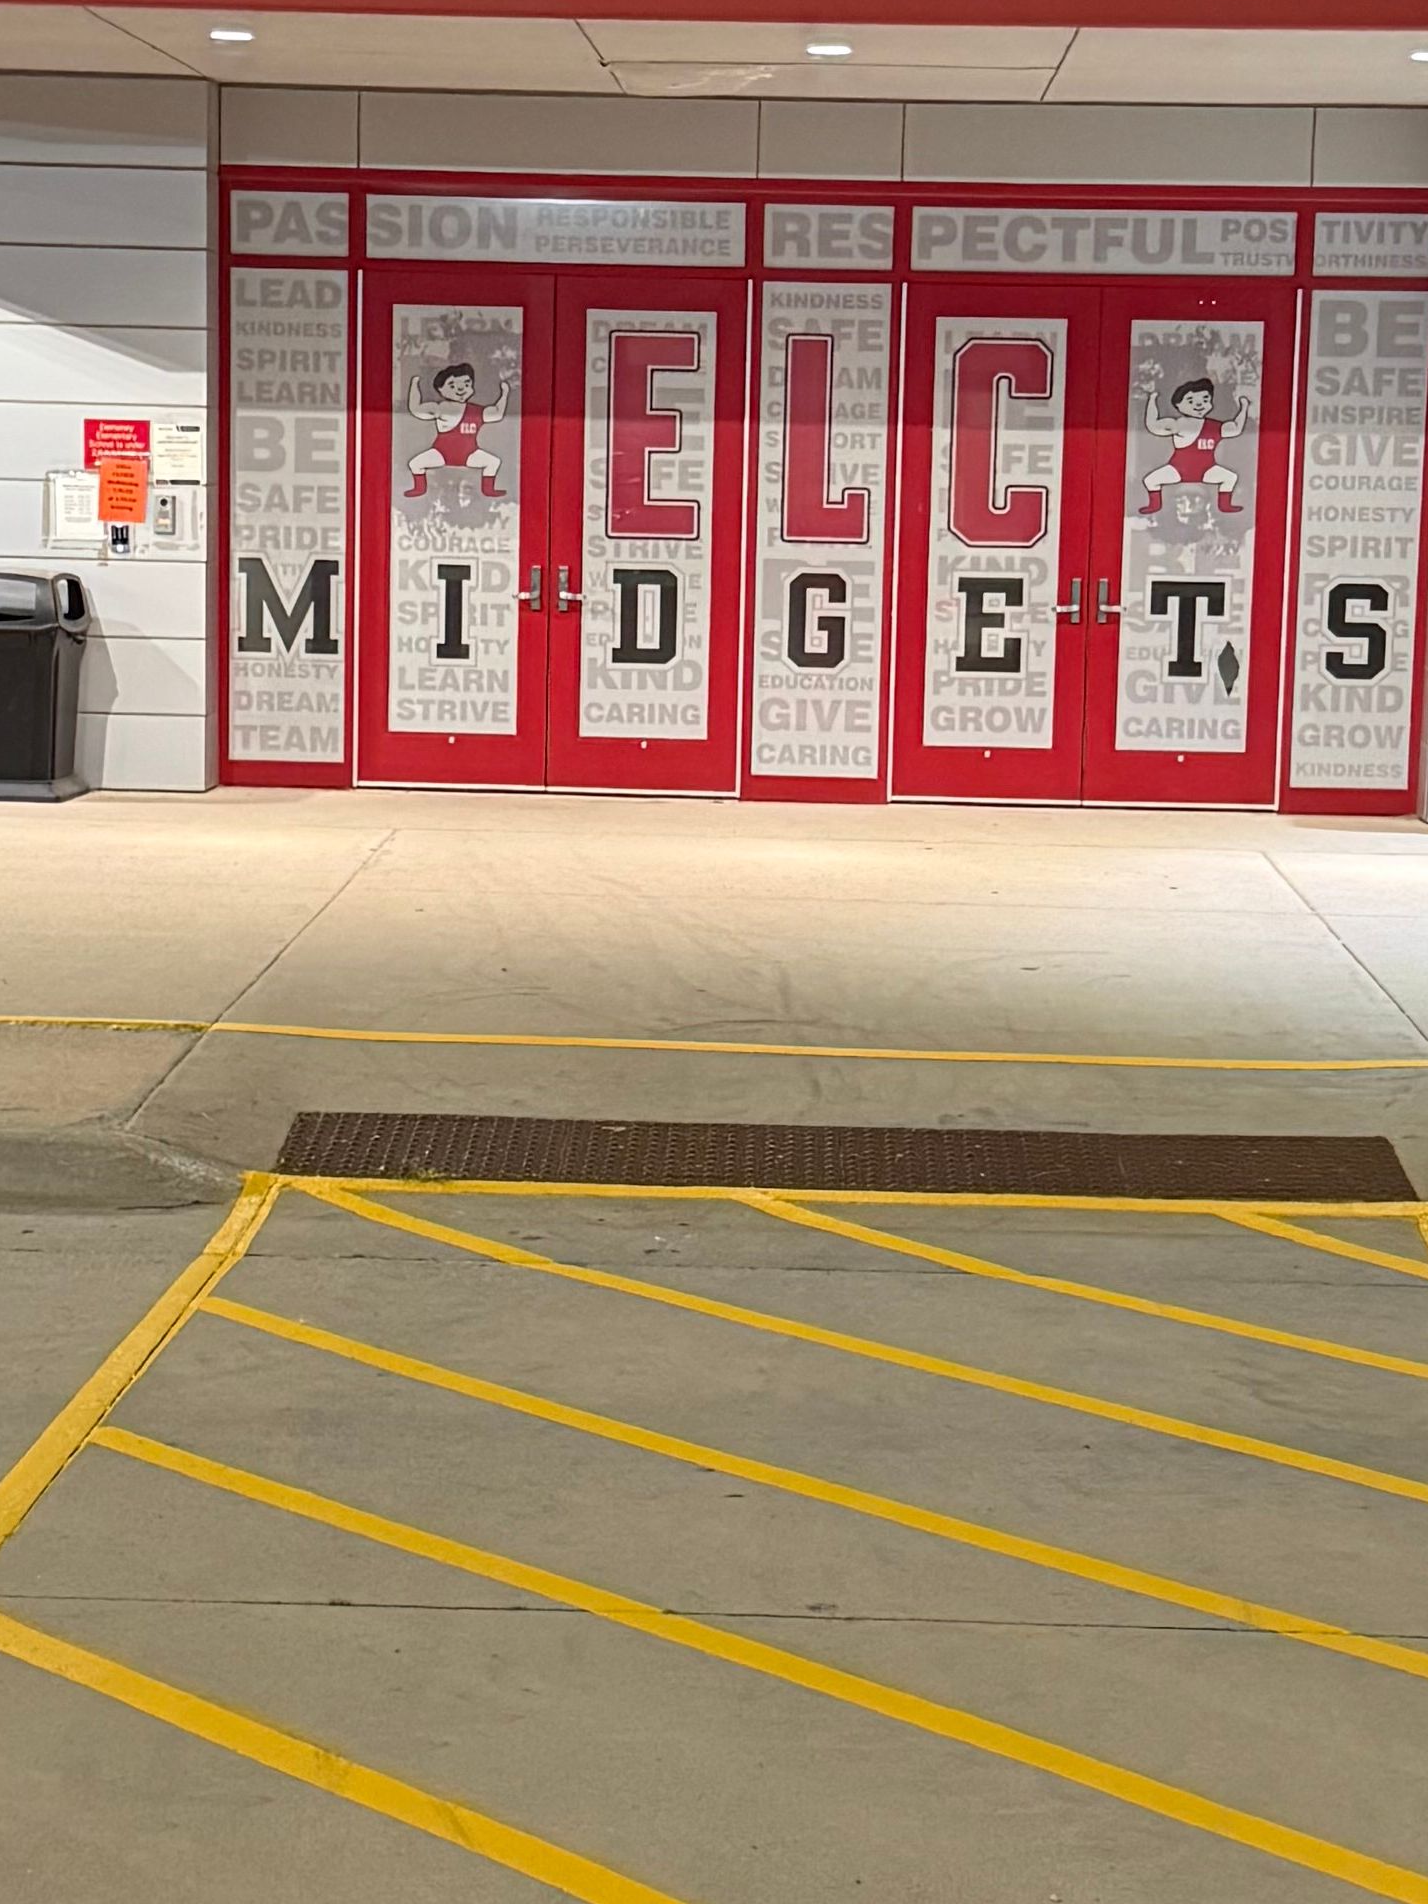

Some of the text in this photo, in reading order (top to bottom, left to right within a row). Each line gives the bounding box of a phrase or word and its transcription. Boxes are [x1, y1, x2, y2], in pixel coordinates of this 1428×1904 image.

[537, 206, 732, 230] RESPONSIBLE
[535, 234, 732, 257] PERSEVERANCE
[236, 278, 342, 309] LEAD
[770, 293, 883, 310] KINDNESS
[236, 322, 342, 338] KINDNESS
[1316, 300, 1425, 358] BE
[236, 348, 342, 373] SPIRIT
[767, 366, 882, 390] DAM
[1314, 366, 1423, 398] SAFE
[236, 380, 341, 405] LEARN
[766, 401, 882, 420] CAGE
[1311, 405, 1421, 425] INSPIRE
[238, 417, 341, 473] BE
[764, 431, 882, 450] SORT
[1310, 434, 1419, 466] GIVE
[1309, 475, 1417, 491] COURAGE
[238, 483, 341, 514] SAFE
[1307, 506, 1414, 523] HONESTY
[236, 524, 341, 551] PRIDE
[398, 534, 512, 553] COURAGE
[1305, 534, 1414, 561] SPIRIT
[235, 662, 339, 680] HONESTY
[398, 667, 509, 693] LEARN
[758, 674, 873, 692] EDUCATION
[235, 690, 340, 714] DREAM
[396, 698, 511, 724] STRIVE
[1299, 683, 1404, 714] KIND
[583, 702, 701, 726] CARING
[759, 698, 873, 733] GIVE
[930, 705, 1048, 735] GROW
[233, 724, 340, 754] TEAM
[1123, 716, 1242, 740] CARING
[1297, 723, 1404, 749] GROW
[756, 742, 873, 768] CARING
[1295, 761, 1403, 779] KINDNESS
